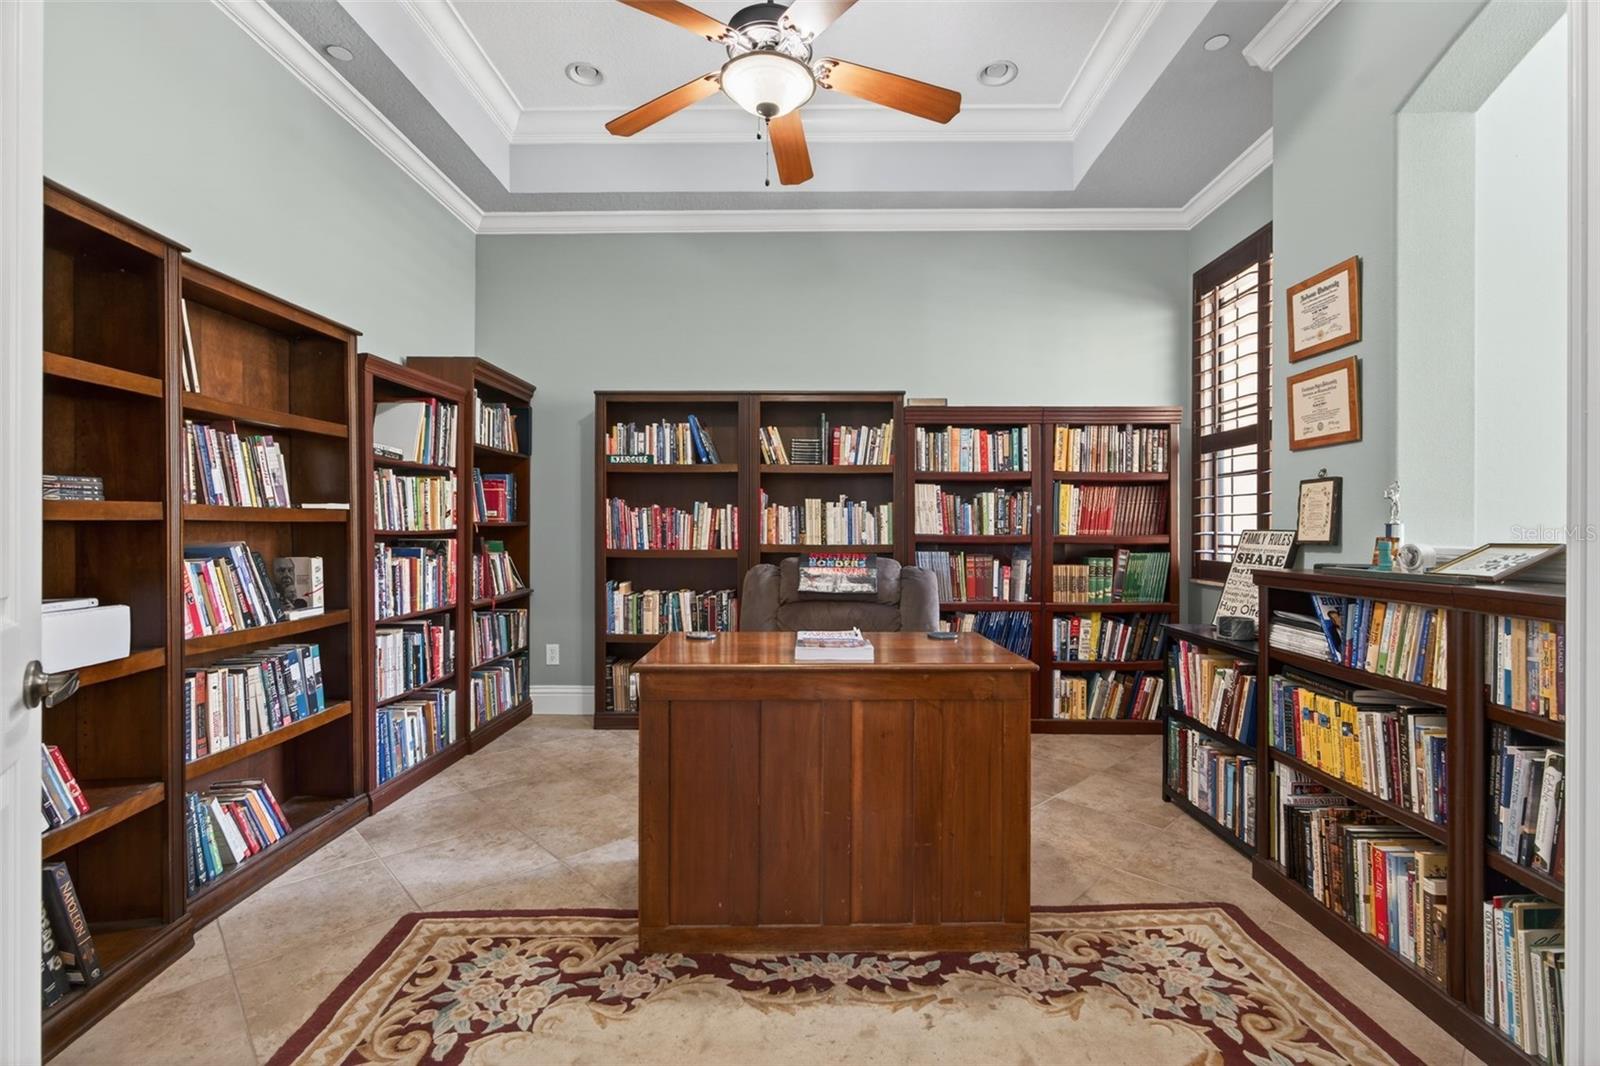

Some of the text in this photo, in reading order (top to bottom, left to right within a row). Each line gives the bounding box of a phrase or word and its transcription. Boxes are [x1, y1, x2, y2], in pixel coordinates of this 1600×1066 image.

[1241, 532, 1293, 546] FAMILY RULES
[1235, 552, 1286, 567] SHARE
[1219, 600, 1237, 615] Hug
[1240, 604, 1260, 617] Ofte
[60, 880, 86, 938] NAPOLEON
